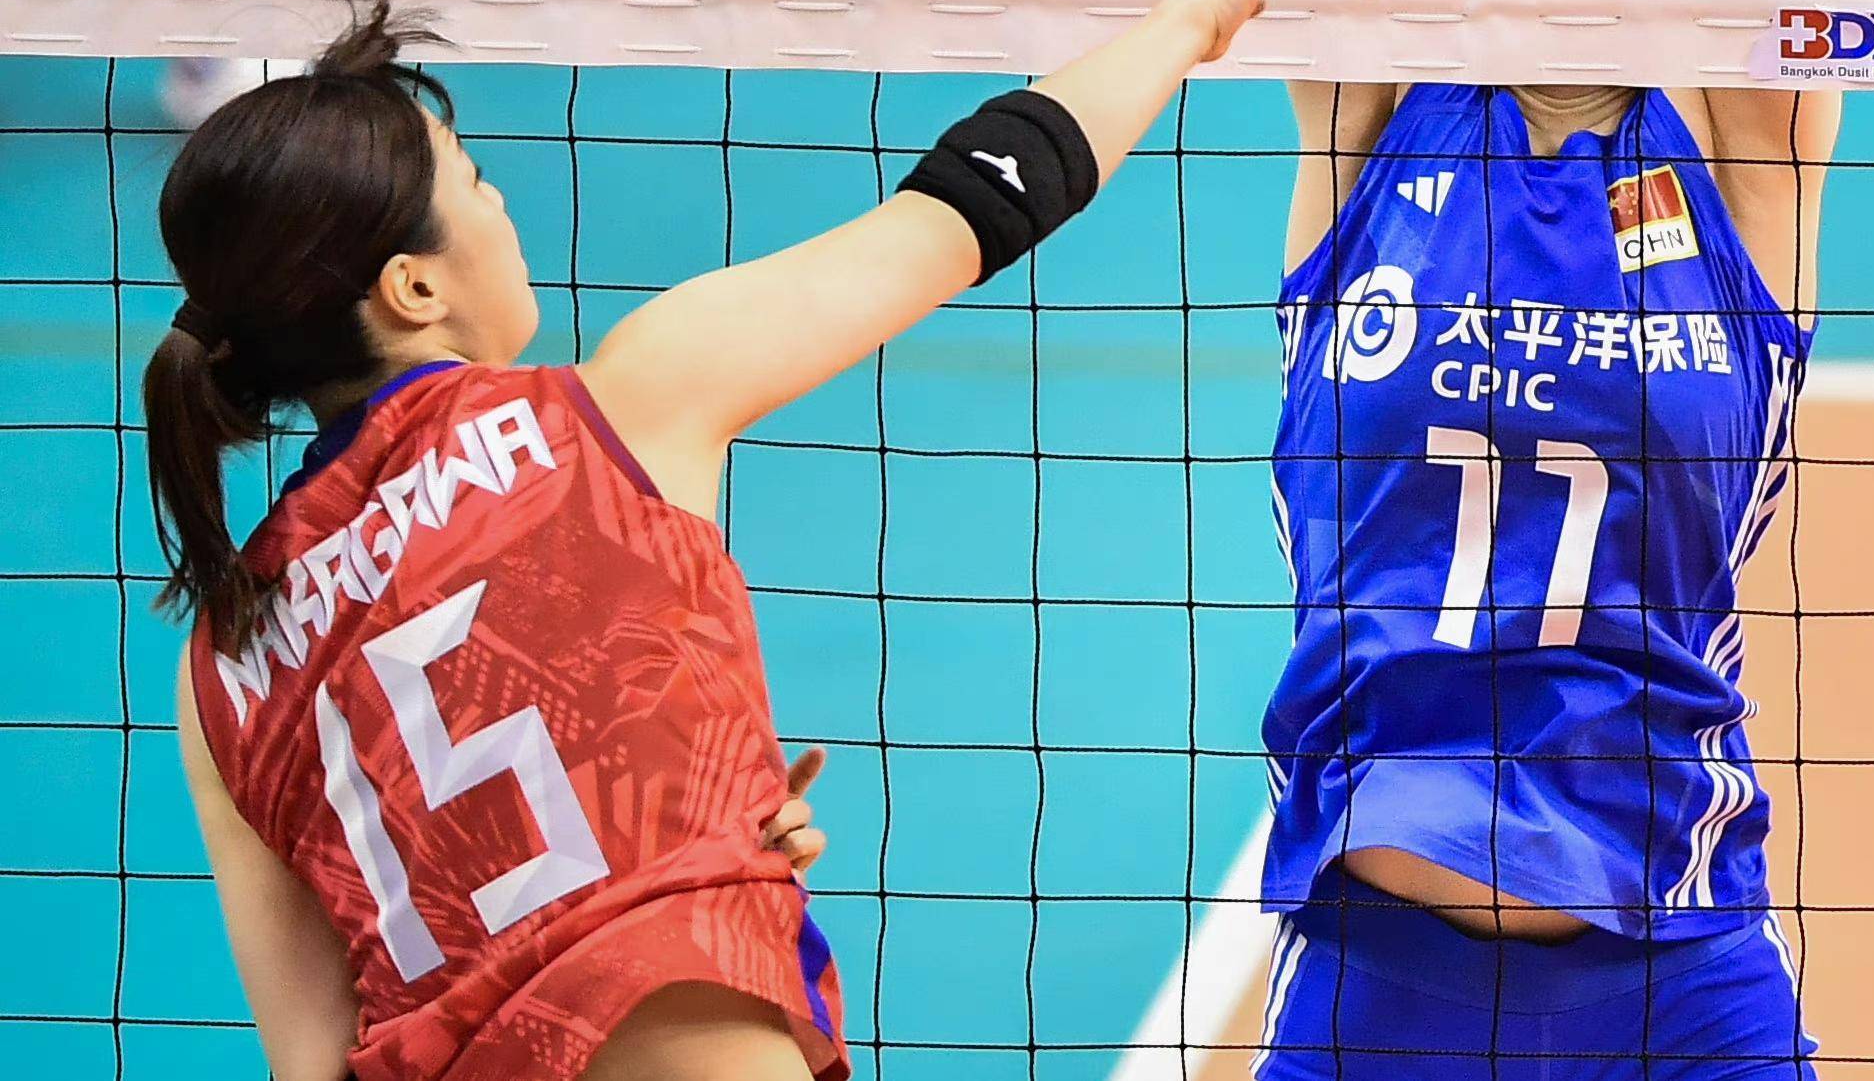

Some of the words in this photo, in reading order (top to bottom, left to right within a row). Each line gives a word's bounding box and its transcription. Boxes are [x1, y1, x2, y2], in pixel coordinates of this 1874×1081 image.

[1781, 65, 1834, 79] Bangkok
[1838, 66, 1869, 79] Dusit
[1623, 227, 1685, 260] CHN
[1435, 292, 1732, 375] 太平洋保险
[1431, 360, 1556, 411] CPIC
[1425, 425, 1610, 650] 11
[314, 579, 611, 983] 15
